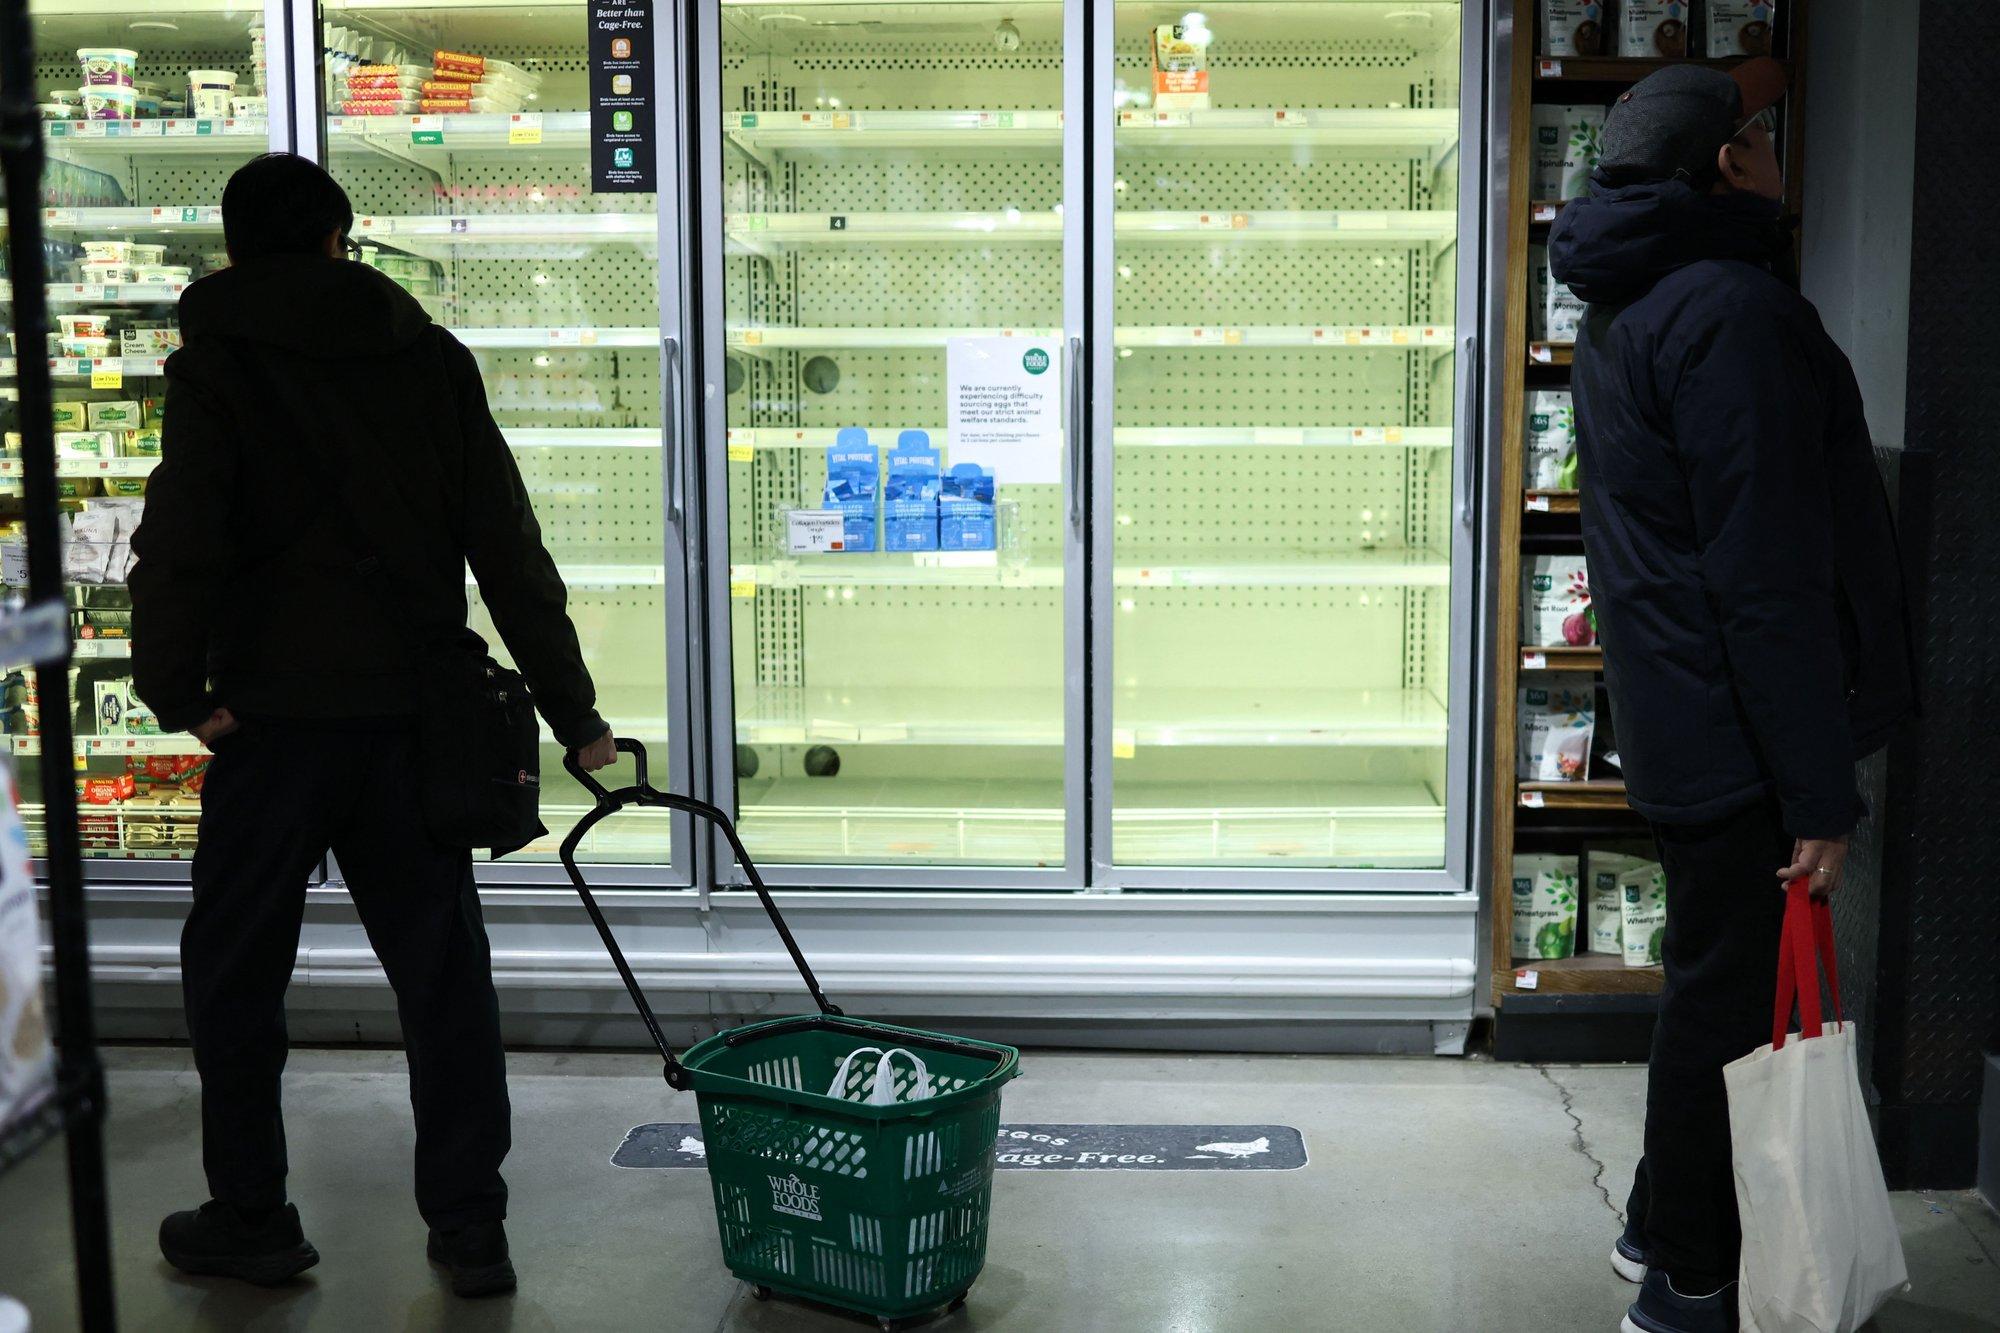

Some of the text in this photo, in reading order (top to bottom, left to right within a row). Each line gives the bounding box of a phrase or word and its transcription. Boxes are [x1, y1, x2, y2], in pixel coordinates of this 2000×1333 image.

[596, 8, 645, 18] Better than
[598, 20, 643, 31] Cage-Free.
[456, 223, 462, 231] 6
[834, 219, 842, 228] 4
[832, 454, 872, 463] VITAL PROTEINS
[893, 456, 934, 466] VITAL PROTEINS
[1525, 723, 1550, 732] Maca
[1514, 910, 1559, 918] Wheatgrass
[995, 1152, 1165, 1166] age-Free.
[766, 1174, 820, 1200] WHOLE
[772, 1190, 820, 1214] FOODS
